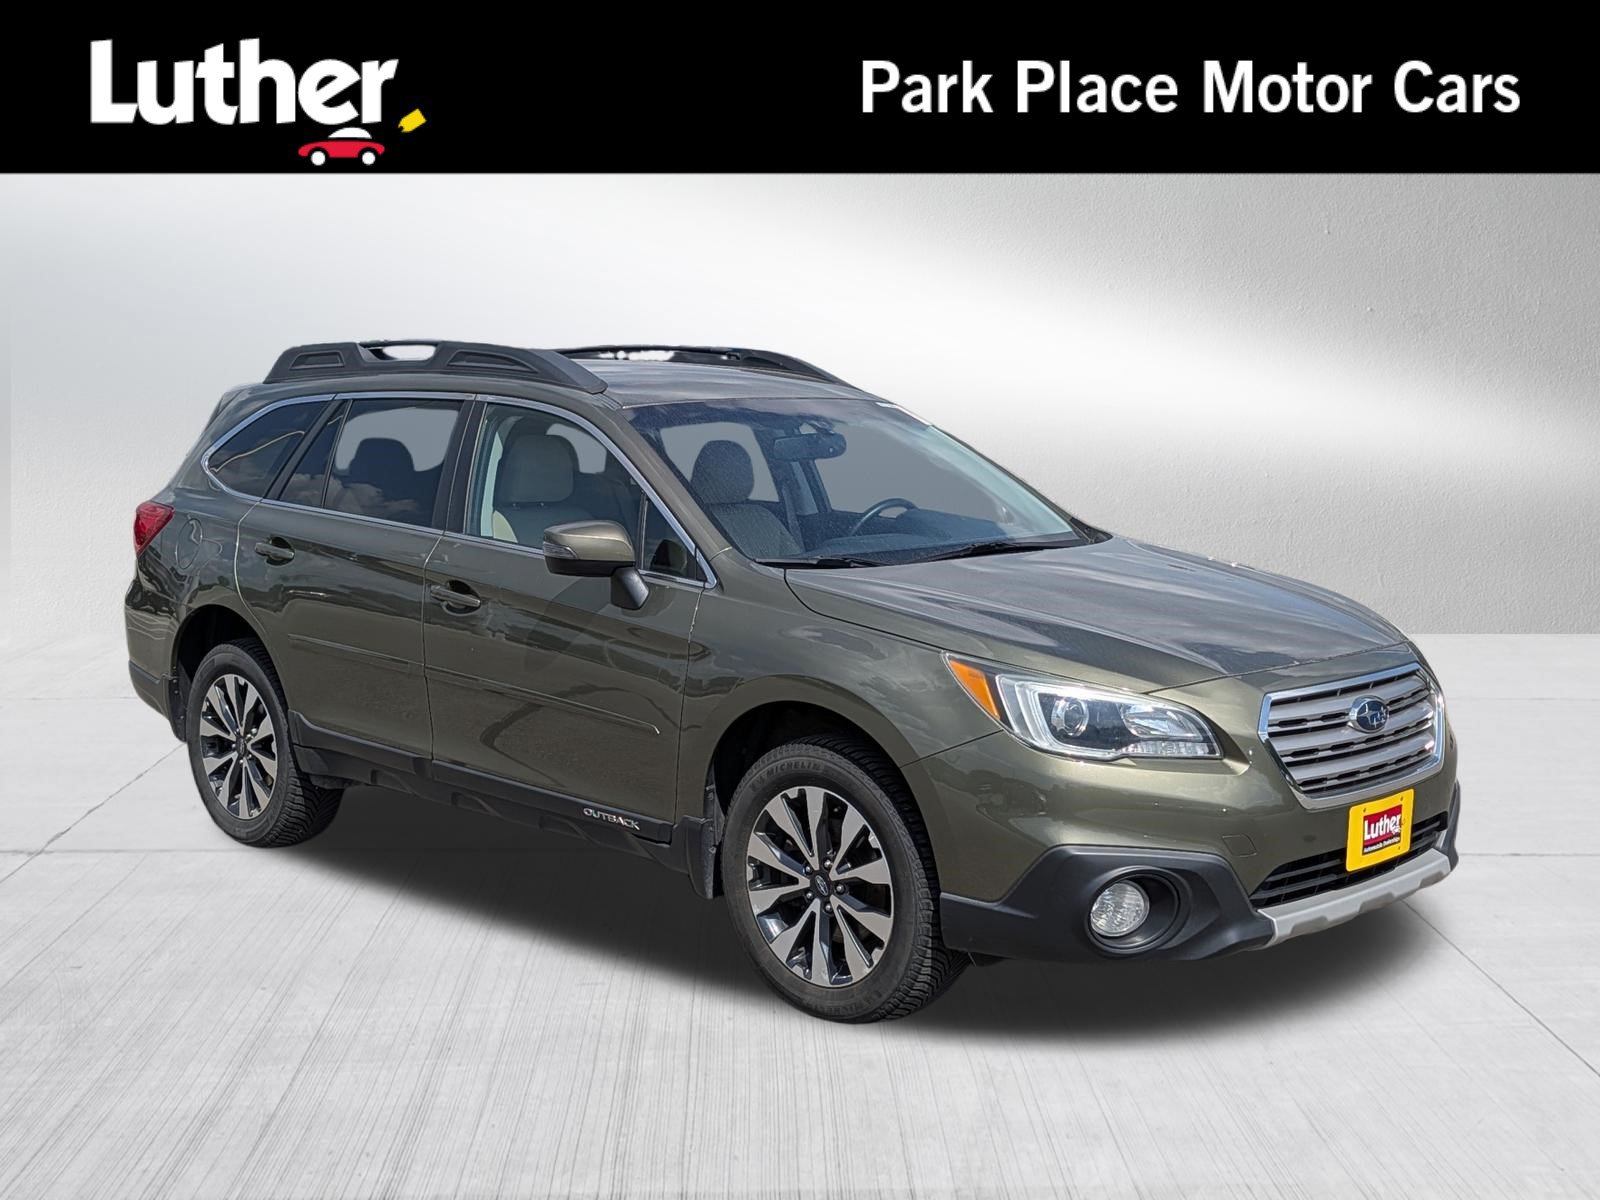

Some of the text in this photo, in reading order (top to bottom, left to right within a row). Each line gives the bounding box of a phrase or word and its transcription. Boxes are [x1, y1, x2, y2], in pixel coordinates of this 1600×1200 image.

[766, 761, 823, 777] MICHELIN
[583, 807, 641, 831] OUTBACK
[1364, 814, 1401, 840] Luther
